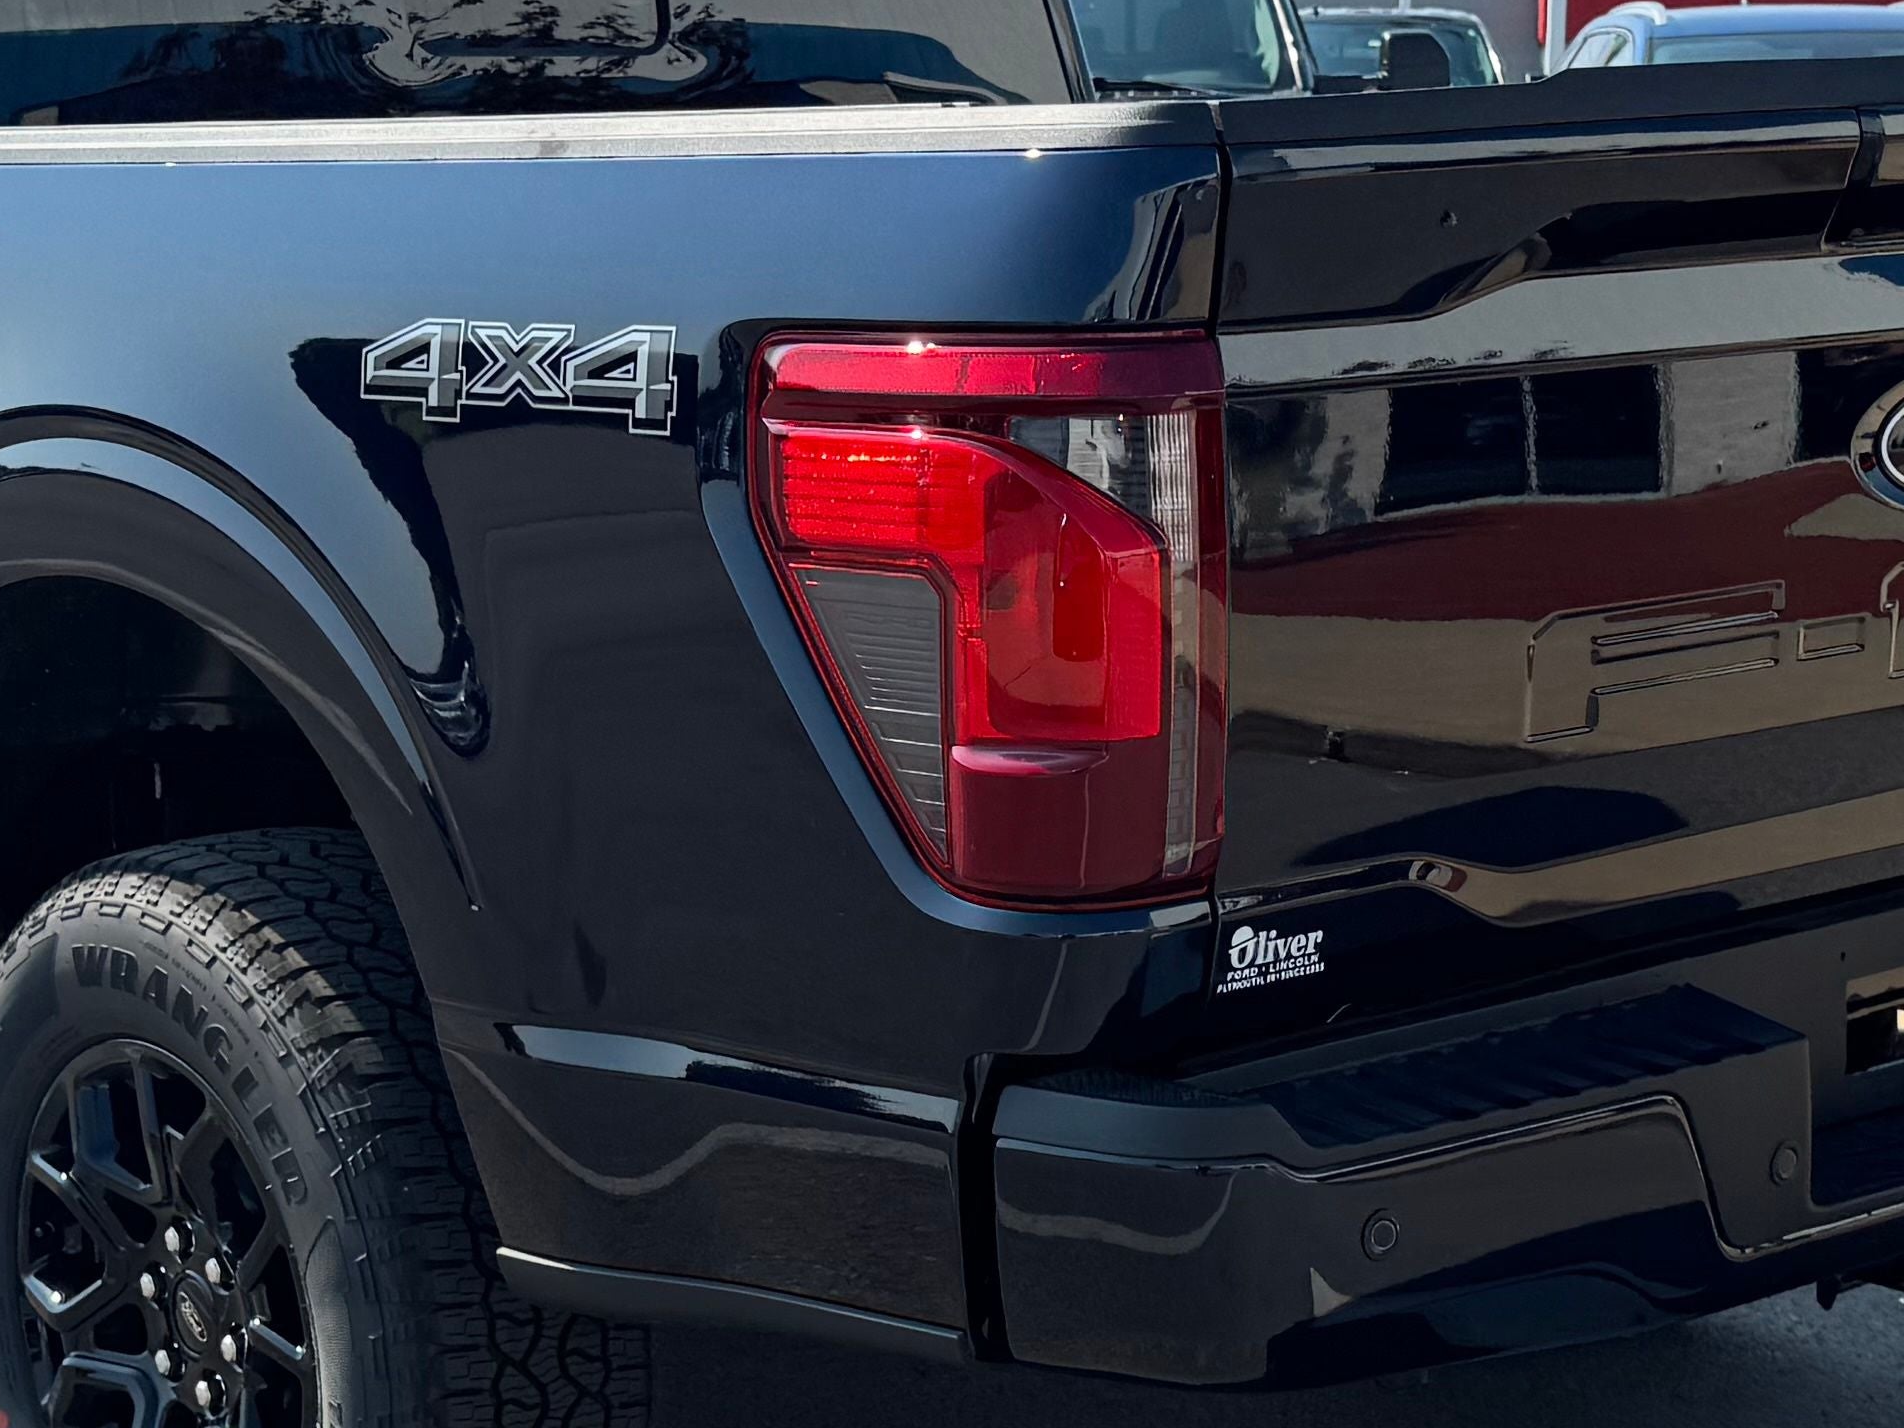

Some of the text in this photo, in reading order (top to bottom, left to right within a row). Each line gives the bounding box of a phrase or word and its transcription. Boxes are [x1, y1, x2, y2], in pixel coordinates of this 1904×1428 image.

[1227, 953, 1320, 982] FORD LINCOLN
[1228, 926, 1324, 969] Oliver
[71, 943, 308, 1206] WRANGLER
